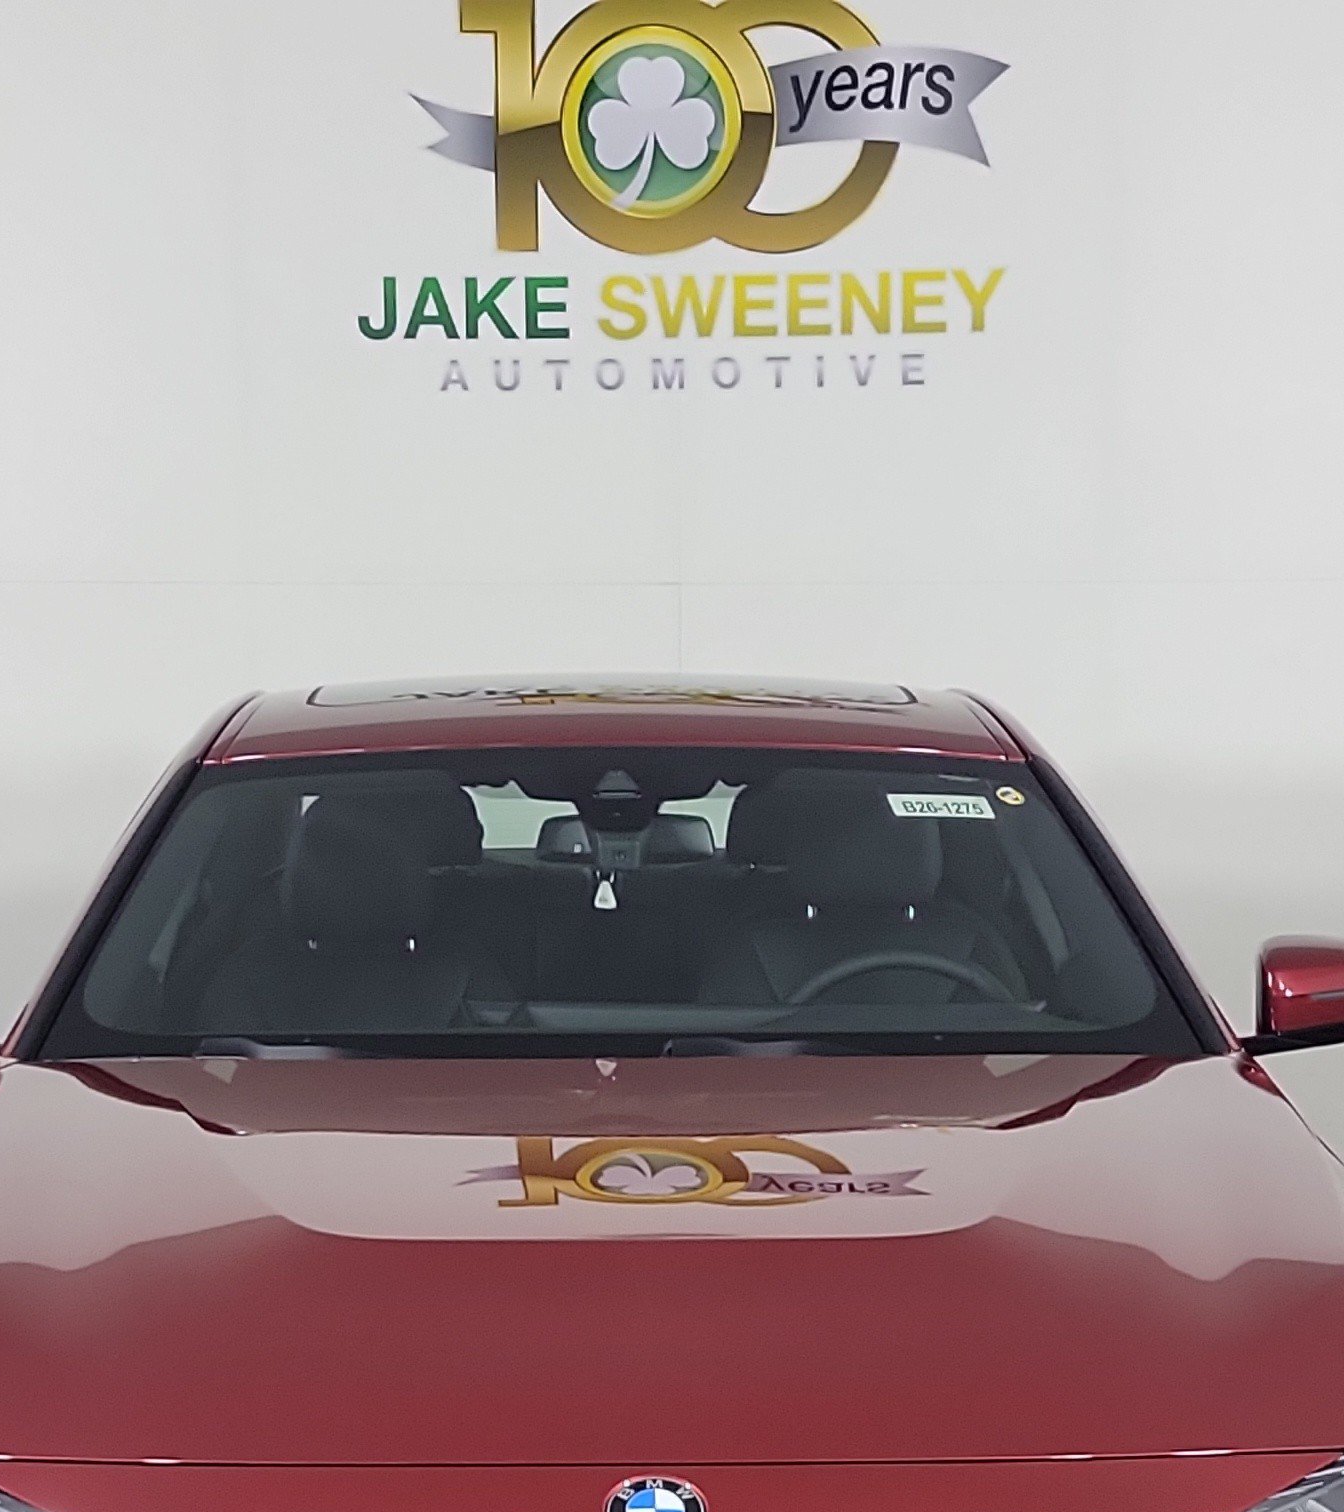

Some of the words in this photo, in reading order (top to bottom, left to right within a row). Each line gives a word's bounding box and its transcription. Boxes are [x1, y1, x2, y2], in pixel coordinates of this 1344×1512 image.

[458, 0, 900, 255] 100
[788, 56, 955, 133] years
[357, 274, 571, 342] JAKE
[597, 267, 1006, 342] SWEENEY
[440, 353, 926, 393] AUTOMOTIVE
